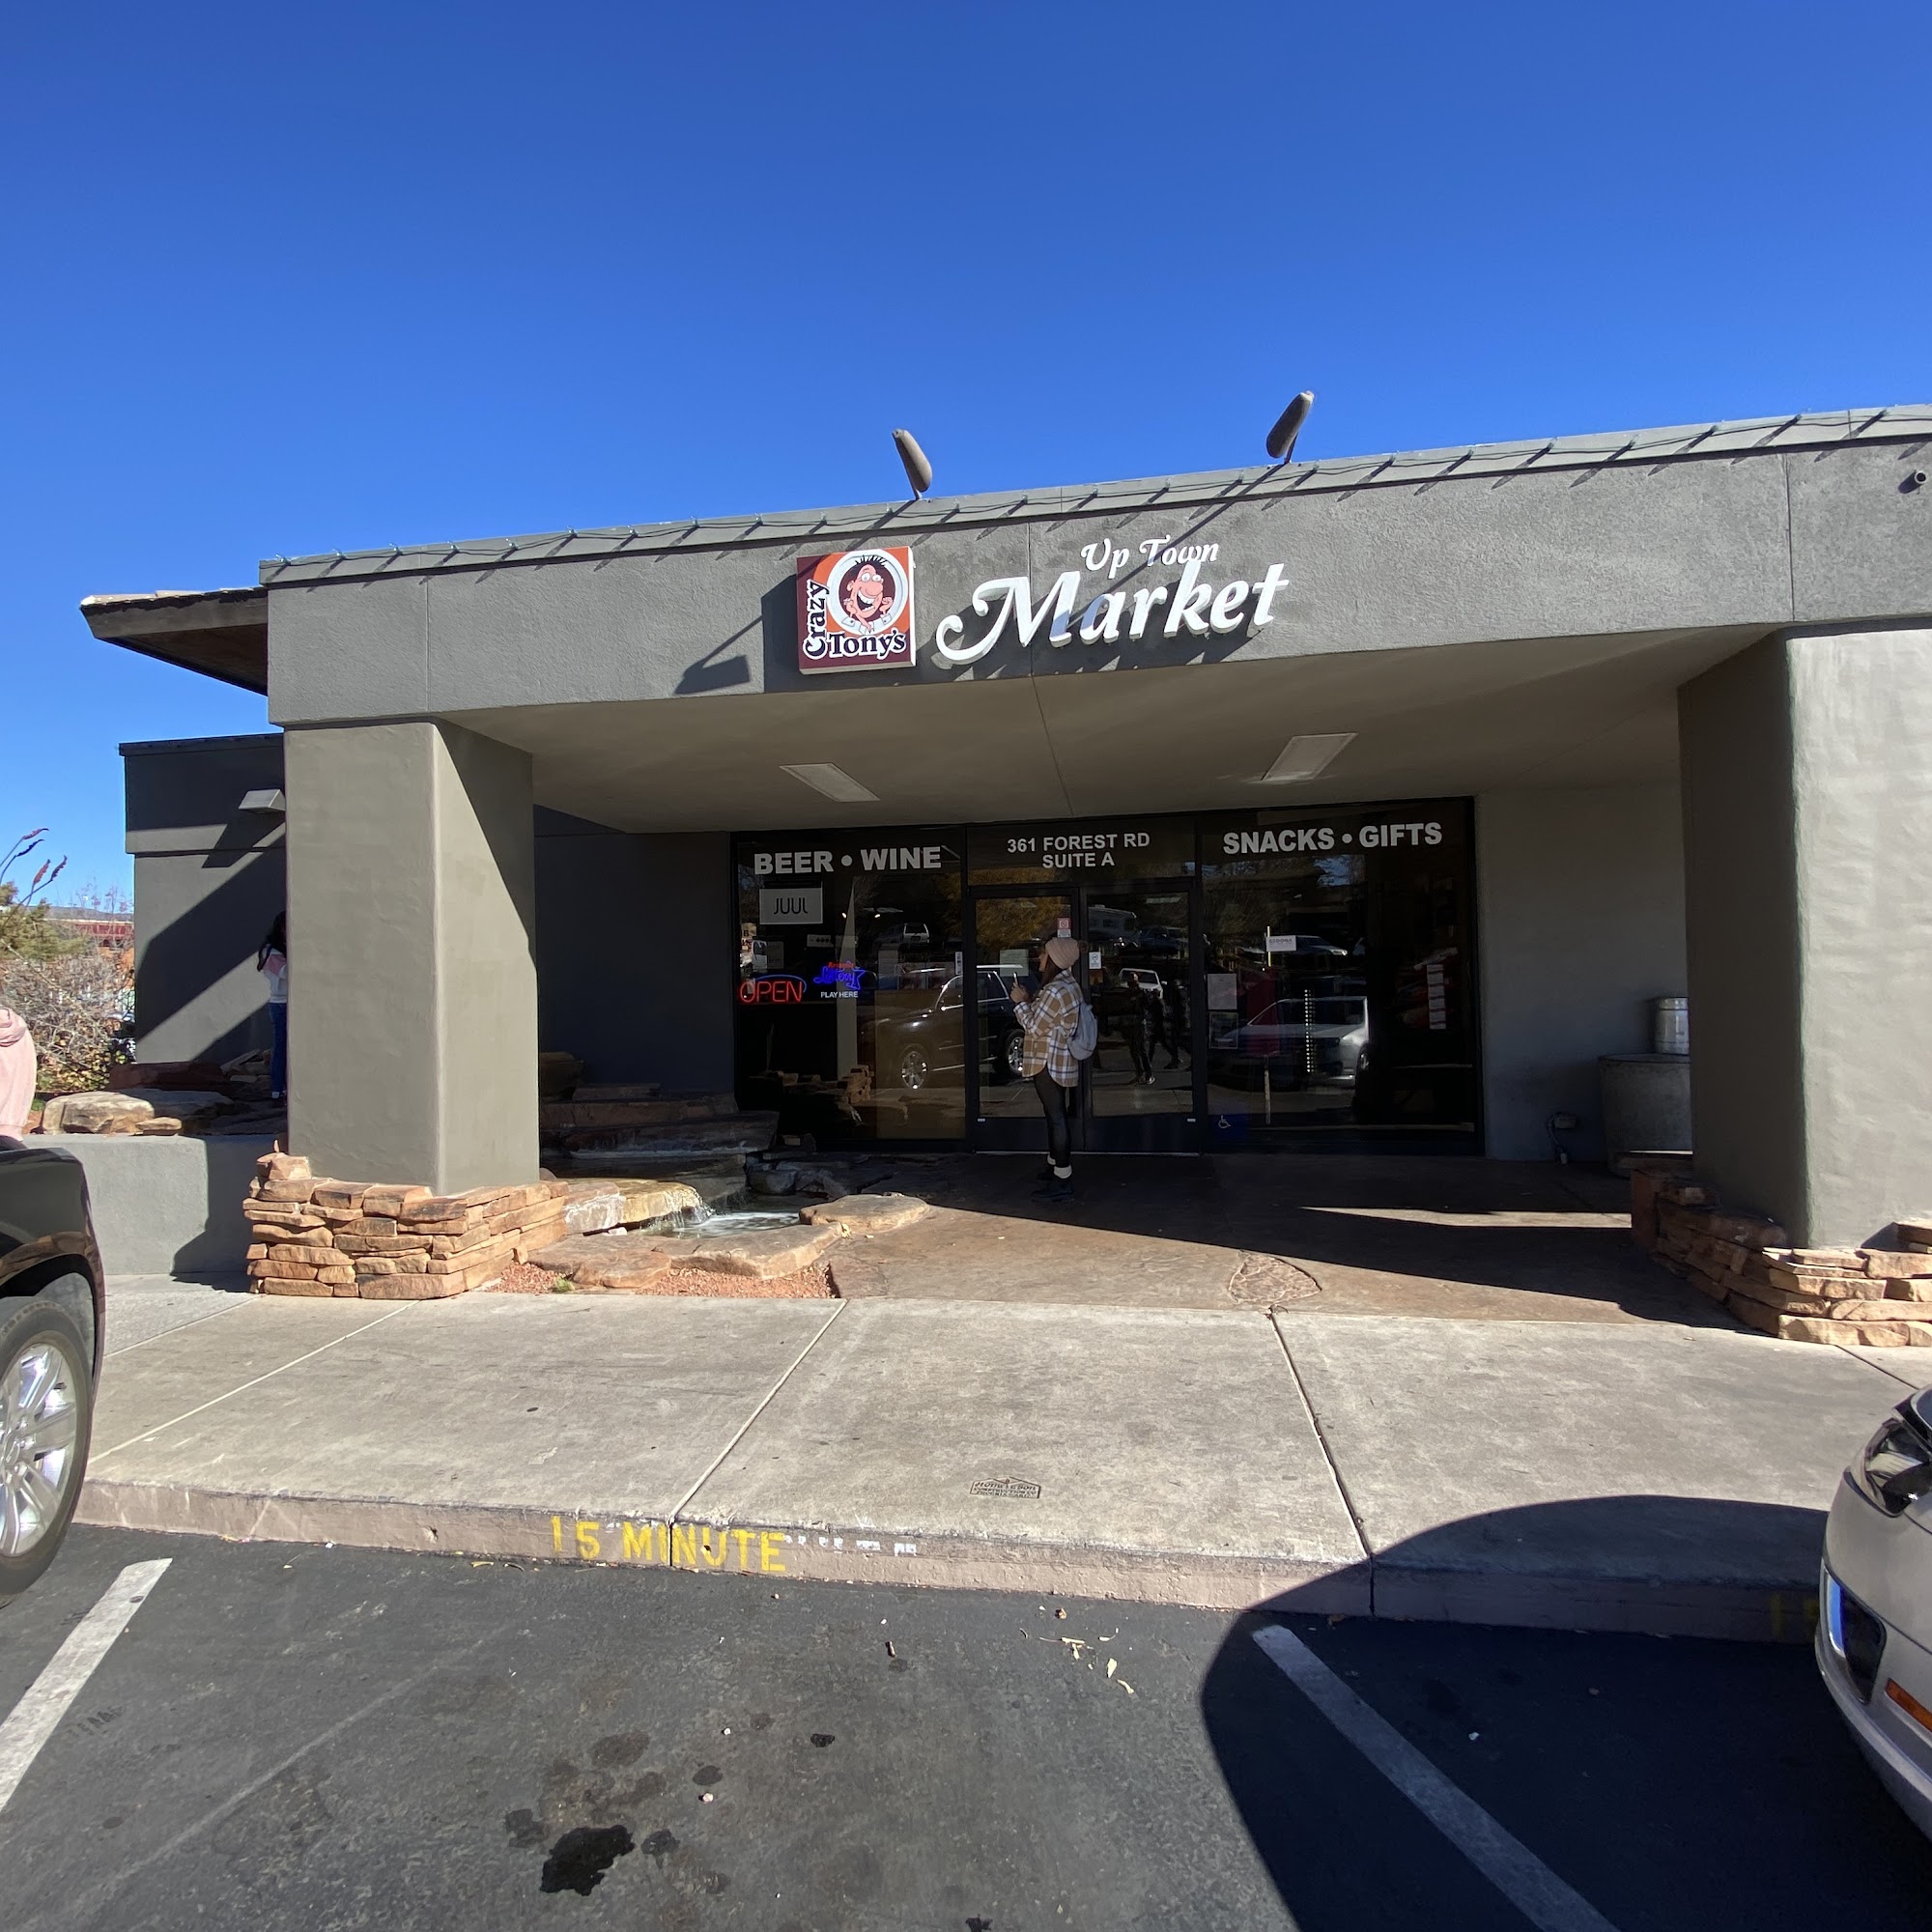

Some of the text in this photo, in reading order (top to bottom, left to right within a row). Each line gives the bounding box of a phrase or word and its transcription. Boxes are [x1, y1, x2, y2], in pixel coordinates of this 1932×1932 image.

[1080, 534, 1219, 580] Up Town
[803, 579, 831, 661] Crazy
[936, 560, 1290, 667] Market
[828, 629, 908, 660] Tony's
[1007, 833, 1151, 853] 361 FOREST RD
[1223, 822, 1443, 855] SNACKS GIFTS
[753, 846, 942, 875] BEER WINE
[1042, 852, 1115, 868] SUITE A
[773, 896, 809, 916] JUUL
[739, 980, 803, 1004] OPEN
[838, 990, 859, 999] HERE
[550, 1516, 601, 1559] 15
[623, 1521, 786, 1573] MINUTE
